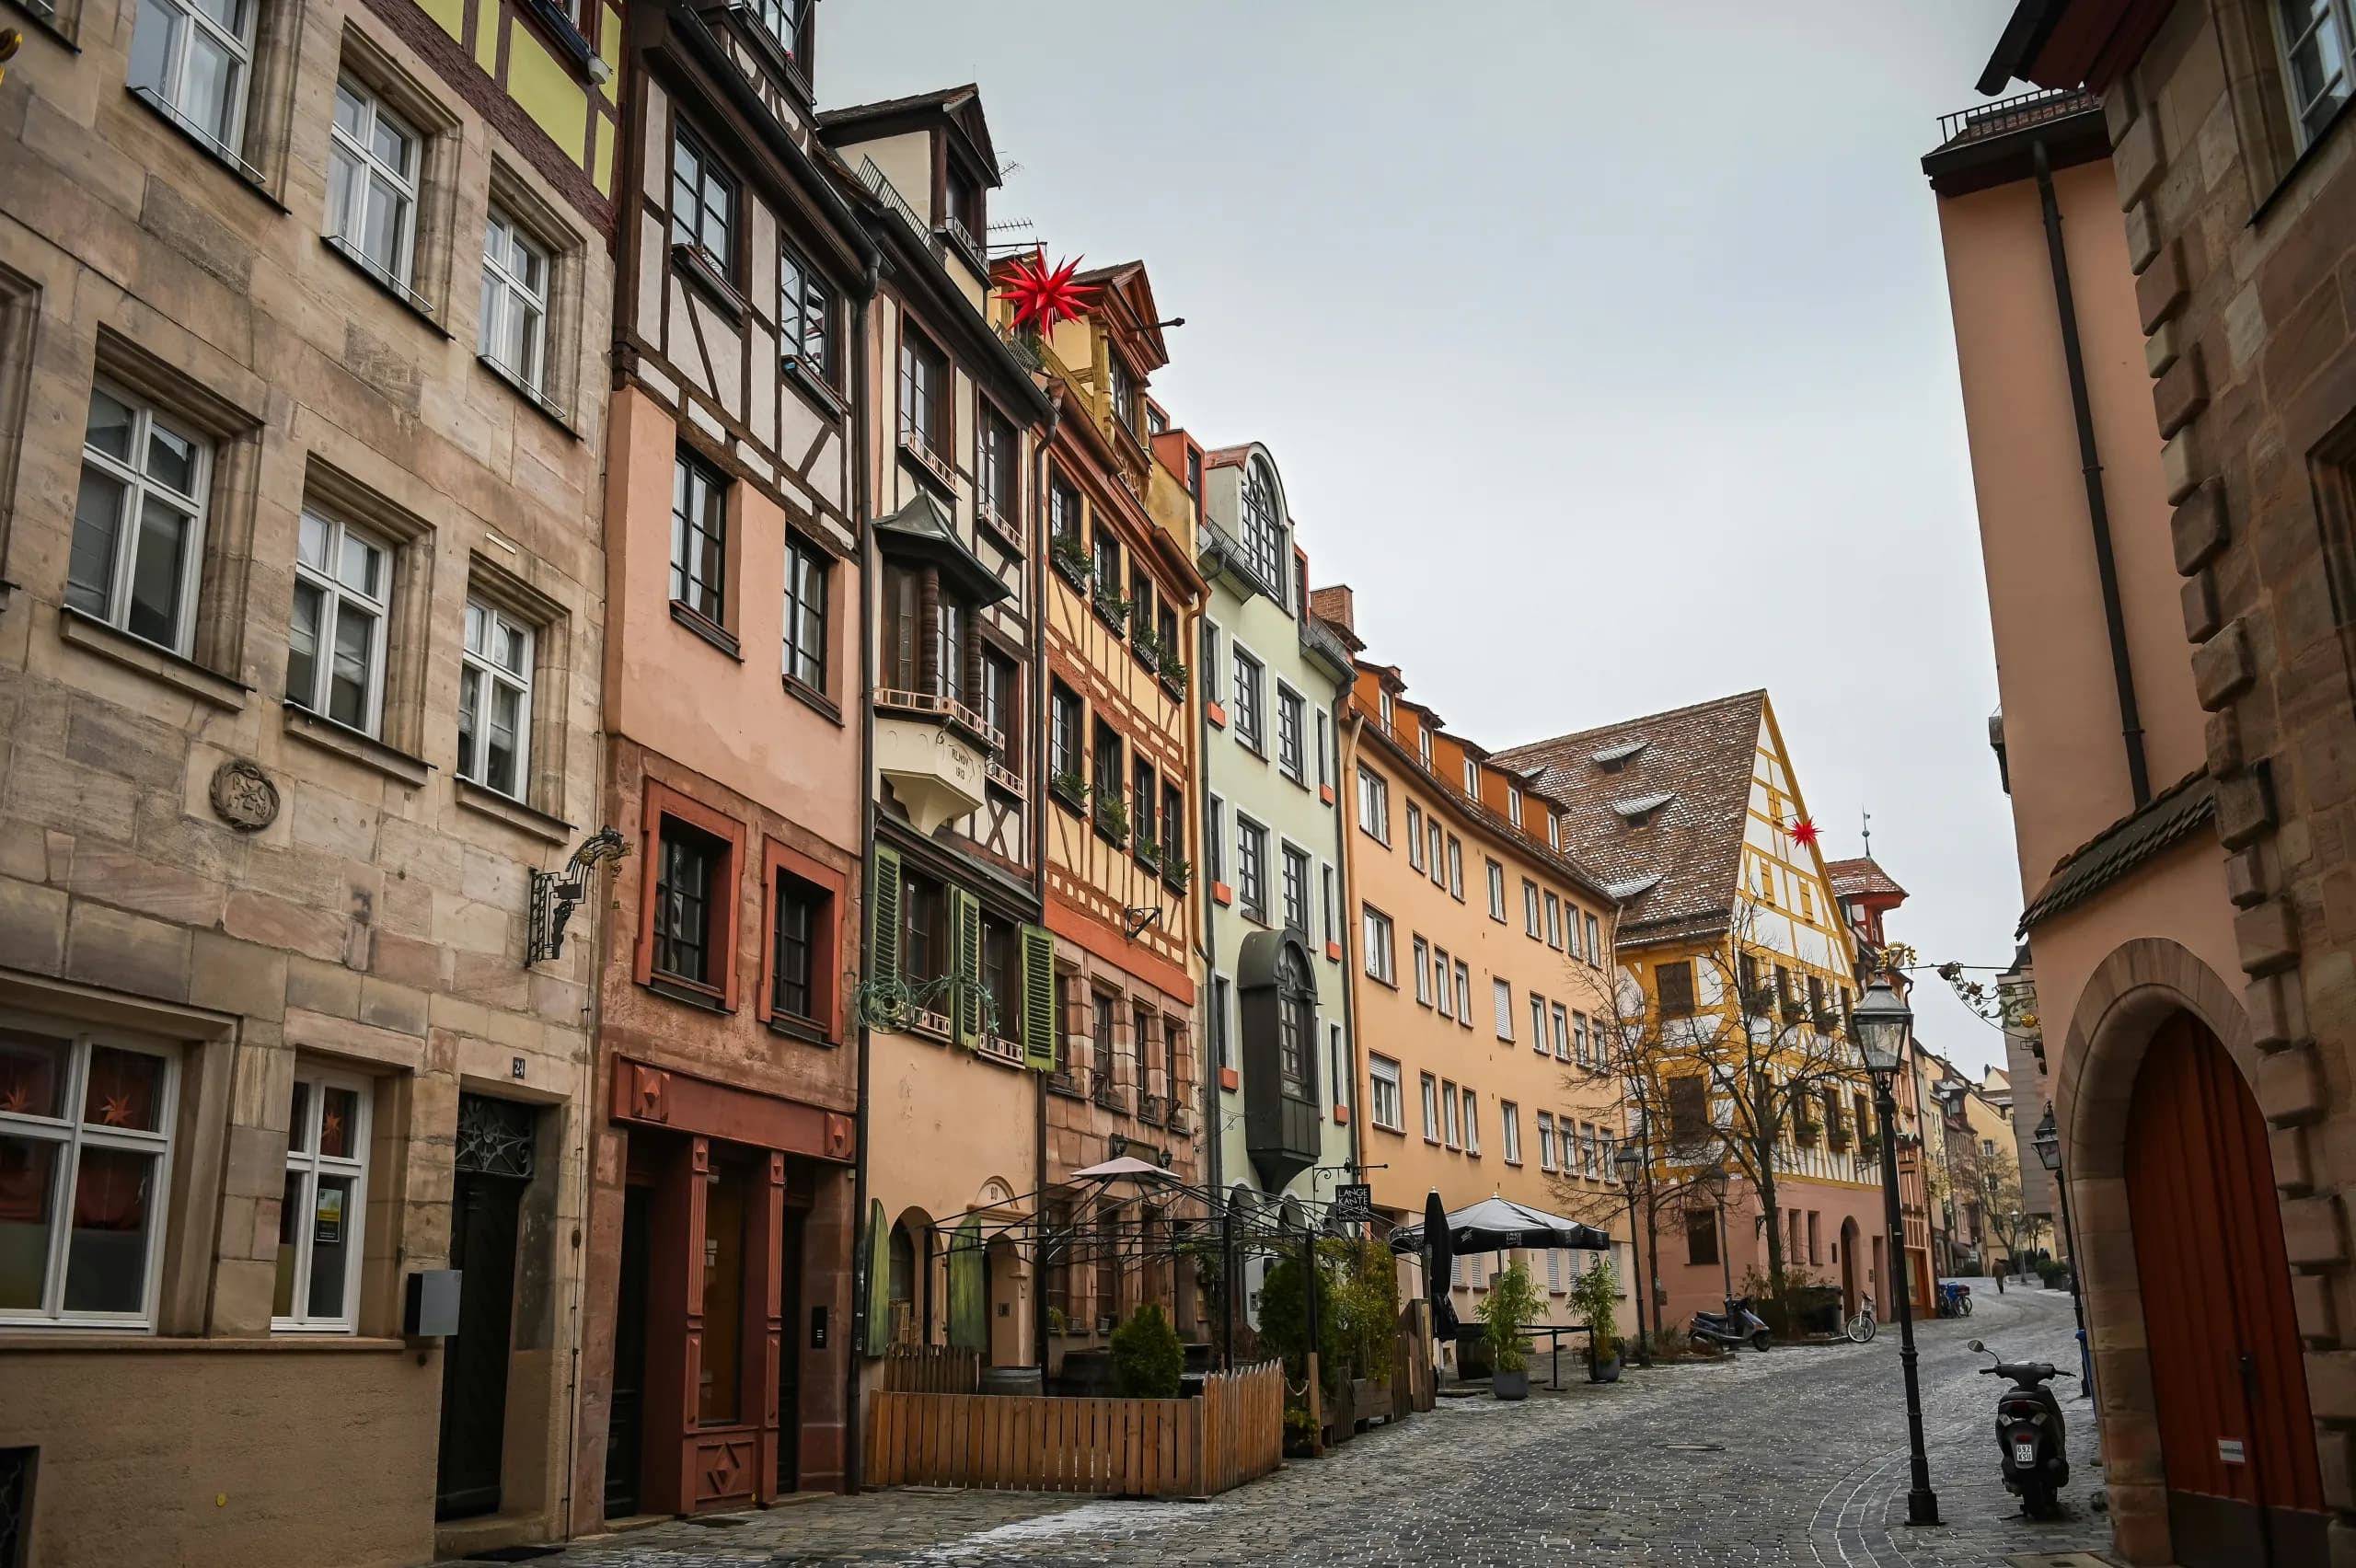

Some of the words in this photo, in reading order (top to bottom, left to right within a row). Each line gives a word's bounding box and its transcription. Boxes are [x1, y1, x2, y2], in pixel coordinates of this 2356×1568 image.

[514, 1060, 524, 1076] 24
[1338, 1188, 1368, 1197] LANGE
[1338, 1197, 1368, 1205] KANTE
[2017, 1445, 2030, 1453] 692
